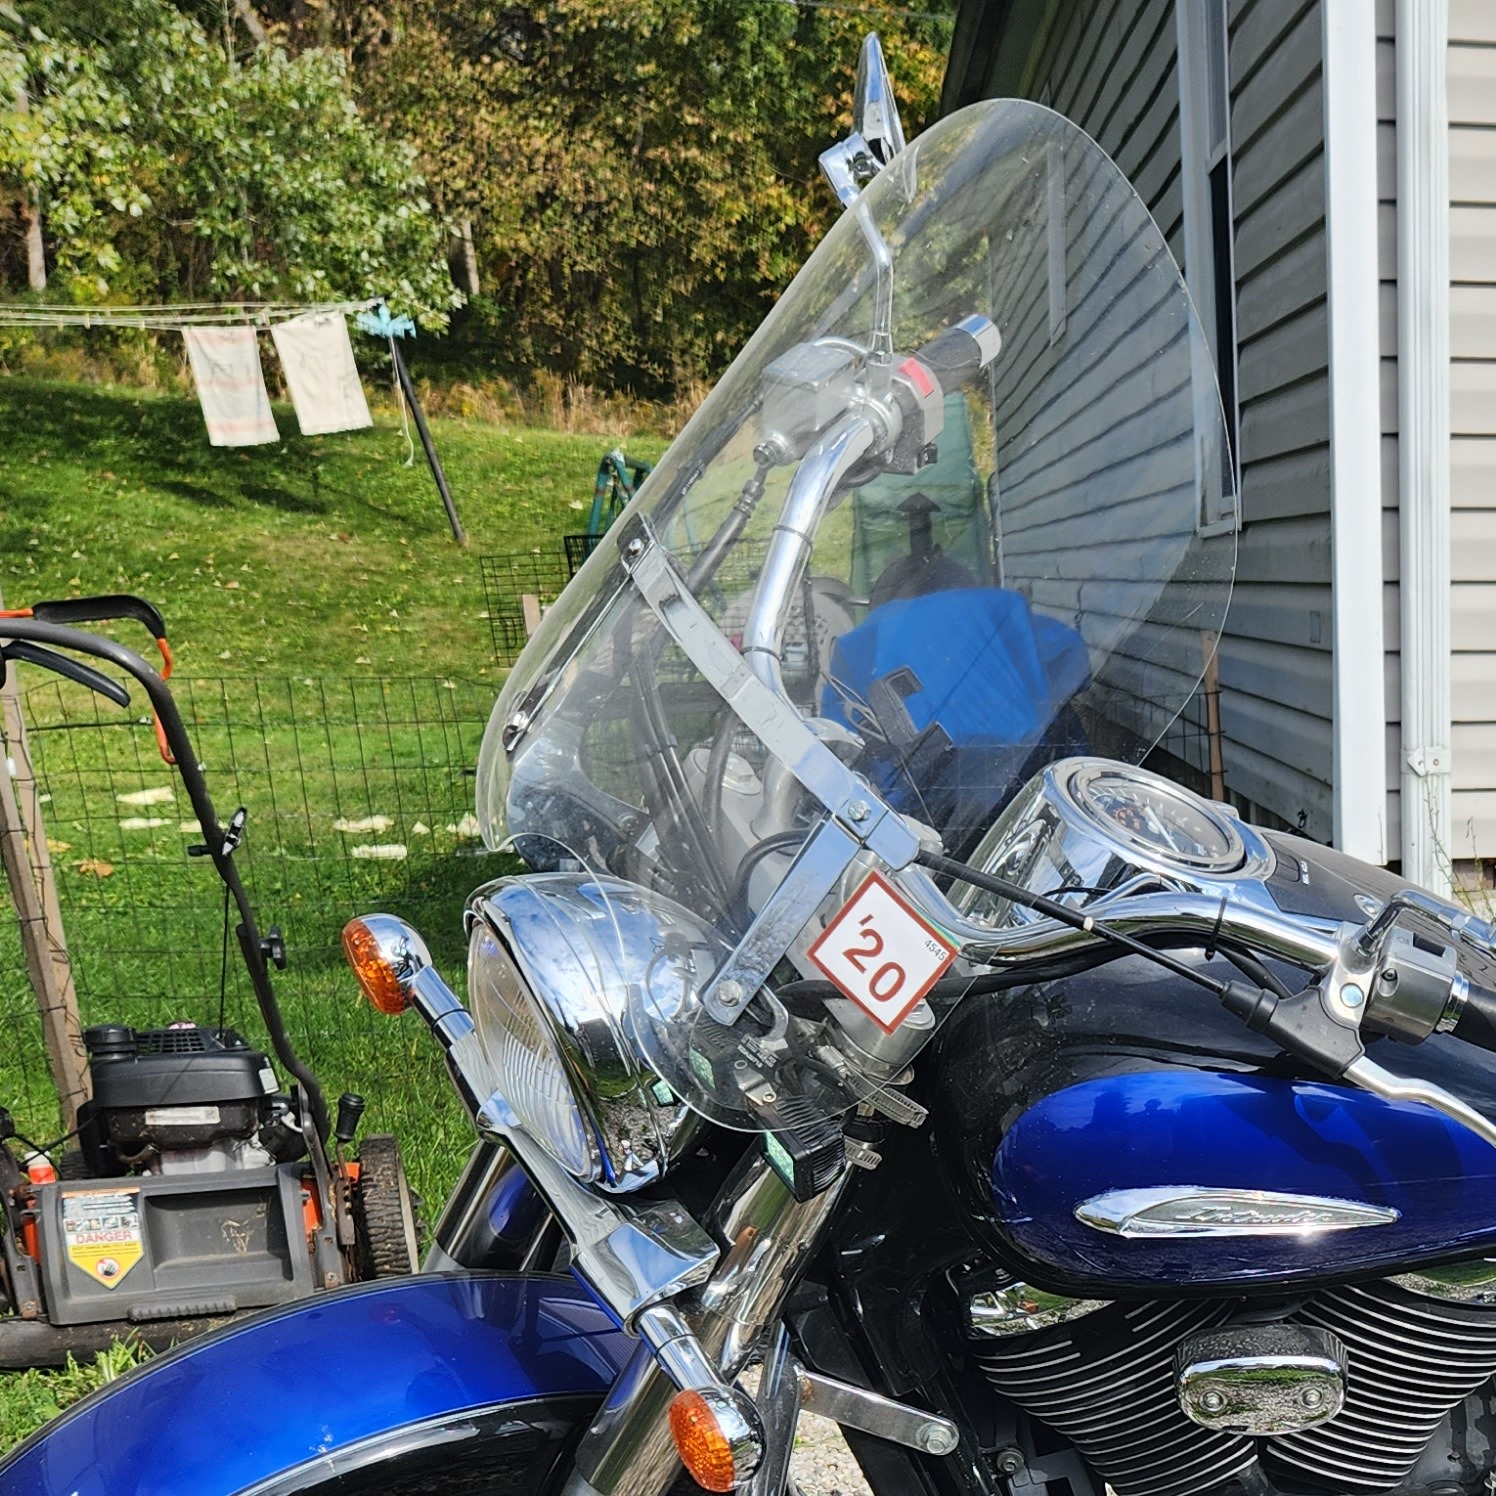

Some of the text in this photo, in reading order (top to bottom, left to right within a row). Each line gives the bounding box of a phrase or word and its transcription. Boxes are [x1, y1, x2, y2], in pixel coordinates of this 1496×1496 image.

[841, 914, 906, 1002] '20
[924, 938, 948, 961] 4545
[75, 1231, 133, 1243] DANGER
